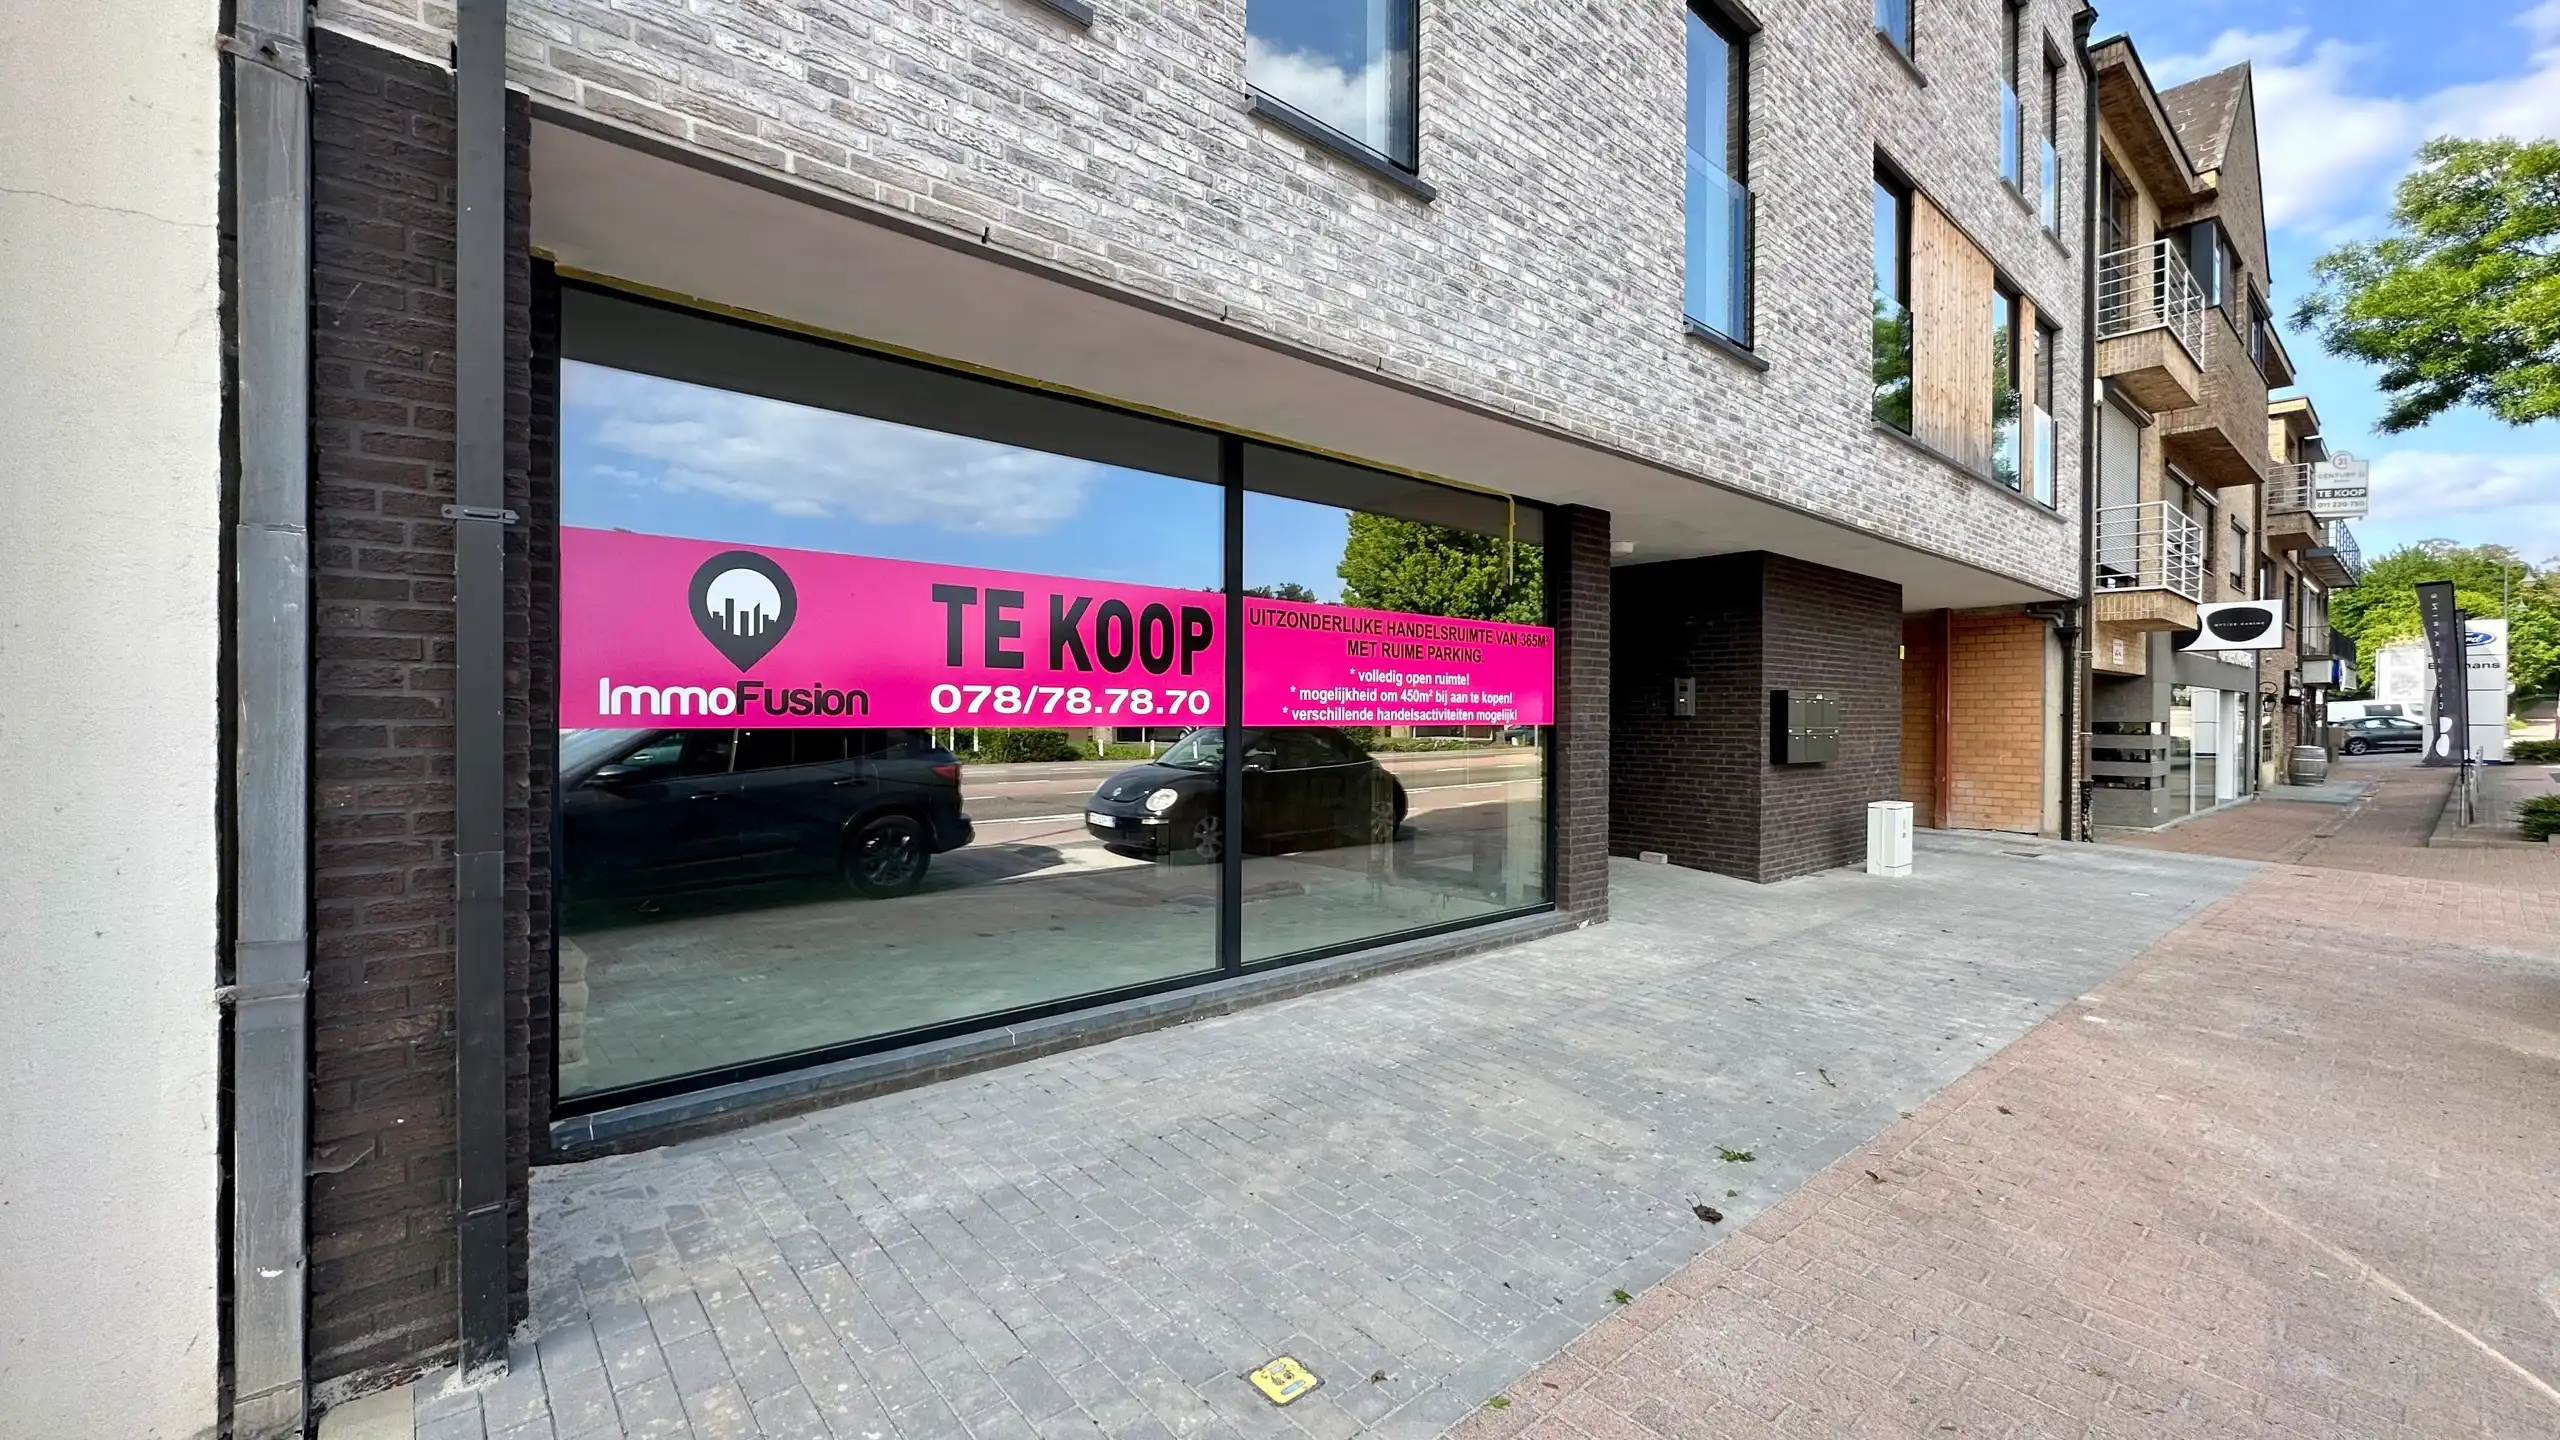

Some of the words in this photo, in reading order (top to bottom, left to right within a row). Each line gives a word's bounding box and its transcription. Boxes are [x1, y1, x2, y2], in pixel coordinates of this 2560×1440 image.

[2317, 490, 2332, 498] TE
[2334, 489, 2365, 497] KOOP
[931, 583, 1025, 669] TE
[1049, 593, 1215, 677] KOOP
[1250, 608, 1382, 634] UITZONDERLIJKE
[1387, 621, 1493, 644] HANDELSRUIMTE
[1496, 631, 1518, 647] VAN
[1347, 640, 1378, 657] MET
[1381, 642, 1424, 660] RUIME
[1358, 669, 1403, 686] volledig
[1405, 673, 1432, 686] open
[1434, 672, 1470, 685] ruimte!
[599, 677, 869, 716] ImmoFusion
[929, 683, 1211, 716] 078/78.78.70
[1299, 687, 1377, 704] mogelijkheid
[1380, 691, 1398, 702] om
[1400, 689, 1433, 703] 450m²
[1435, 690, 1448, 706] bij
[1450, 694, 1468, 704] aan
[1470, 693, 1480, 704] te
[1482, 692, 1513, 706] kopen!
[1291, 707, 1374, 721] verschillende
[1376, 707, 1474, 721] handelsactiviteiten
[1476, 709, 1518, 724] mogelijk!
